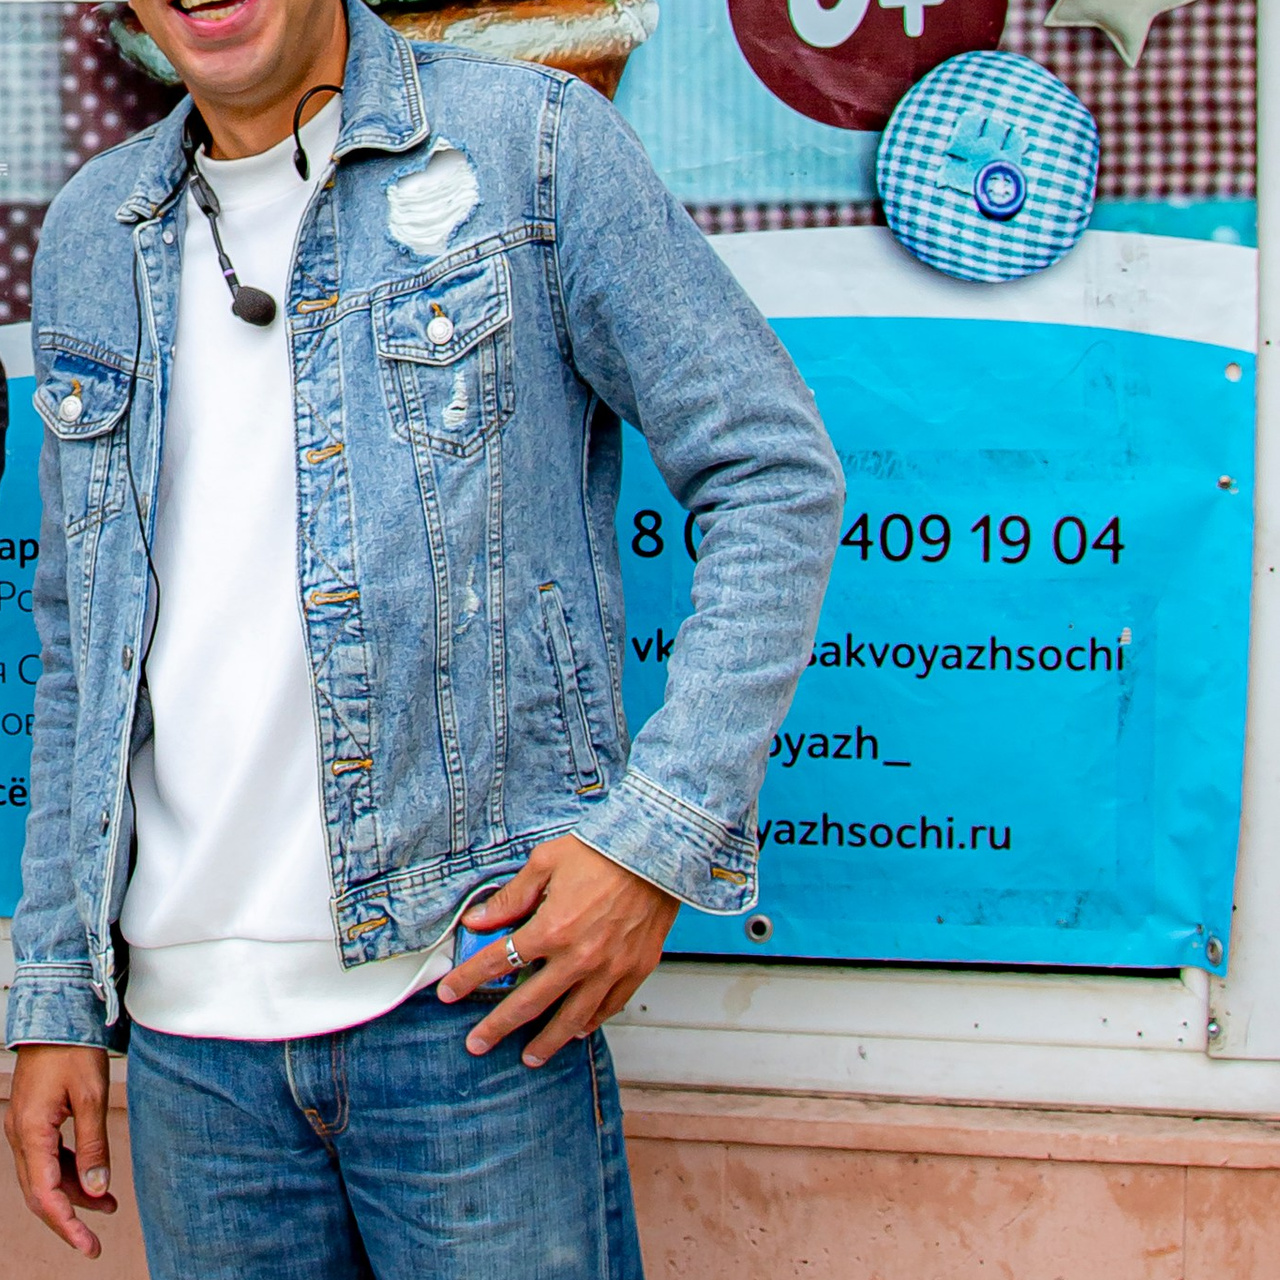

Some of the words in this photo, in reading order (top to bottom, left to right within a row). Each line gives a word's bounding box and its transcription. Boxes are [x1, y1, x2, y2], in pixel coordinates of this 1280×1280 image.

[631, 509, 664, 558] 8
[840, 513, 951, 563] 409
[971, 514, 1030, 563] 19
[1051, 516, 1125, 565] 04
